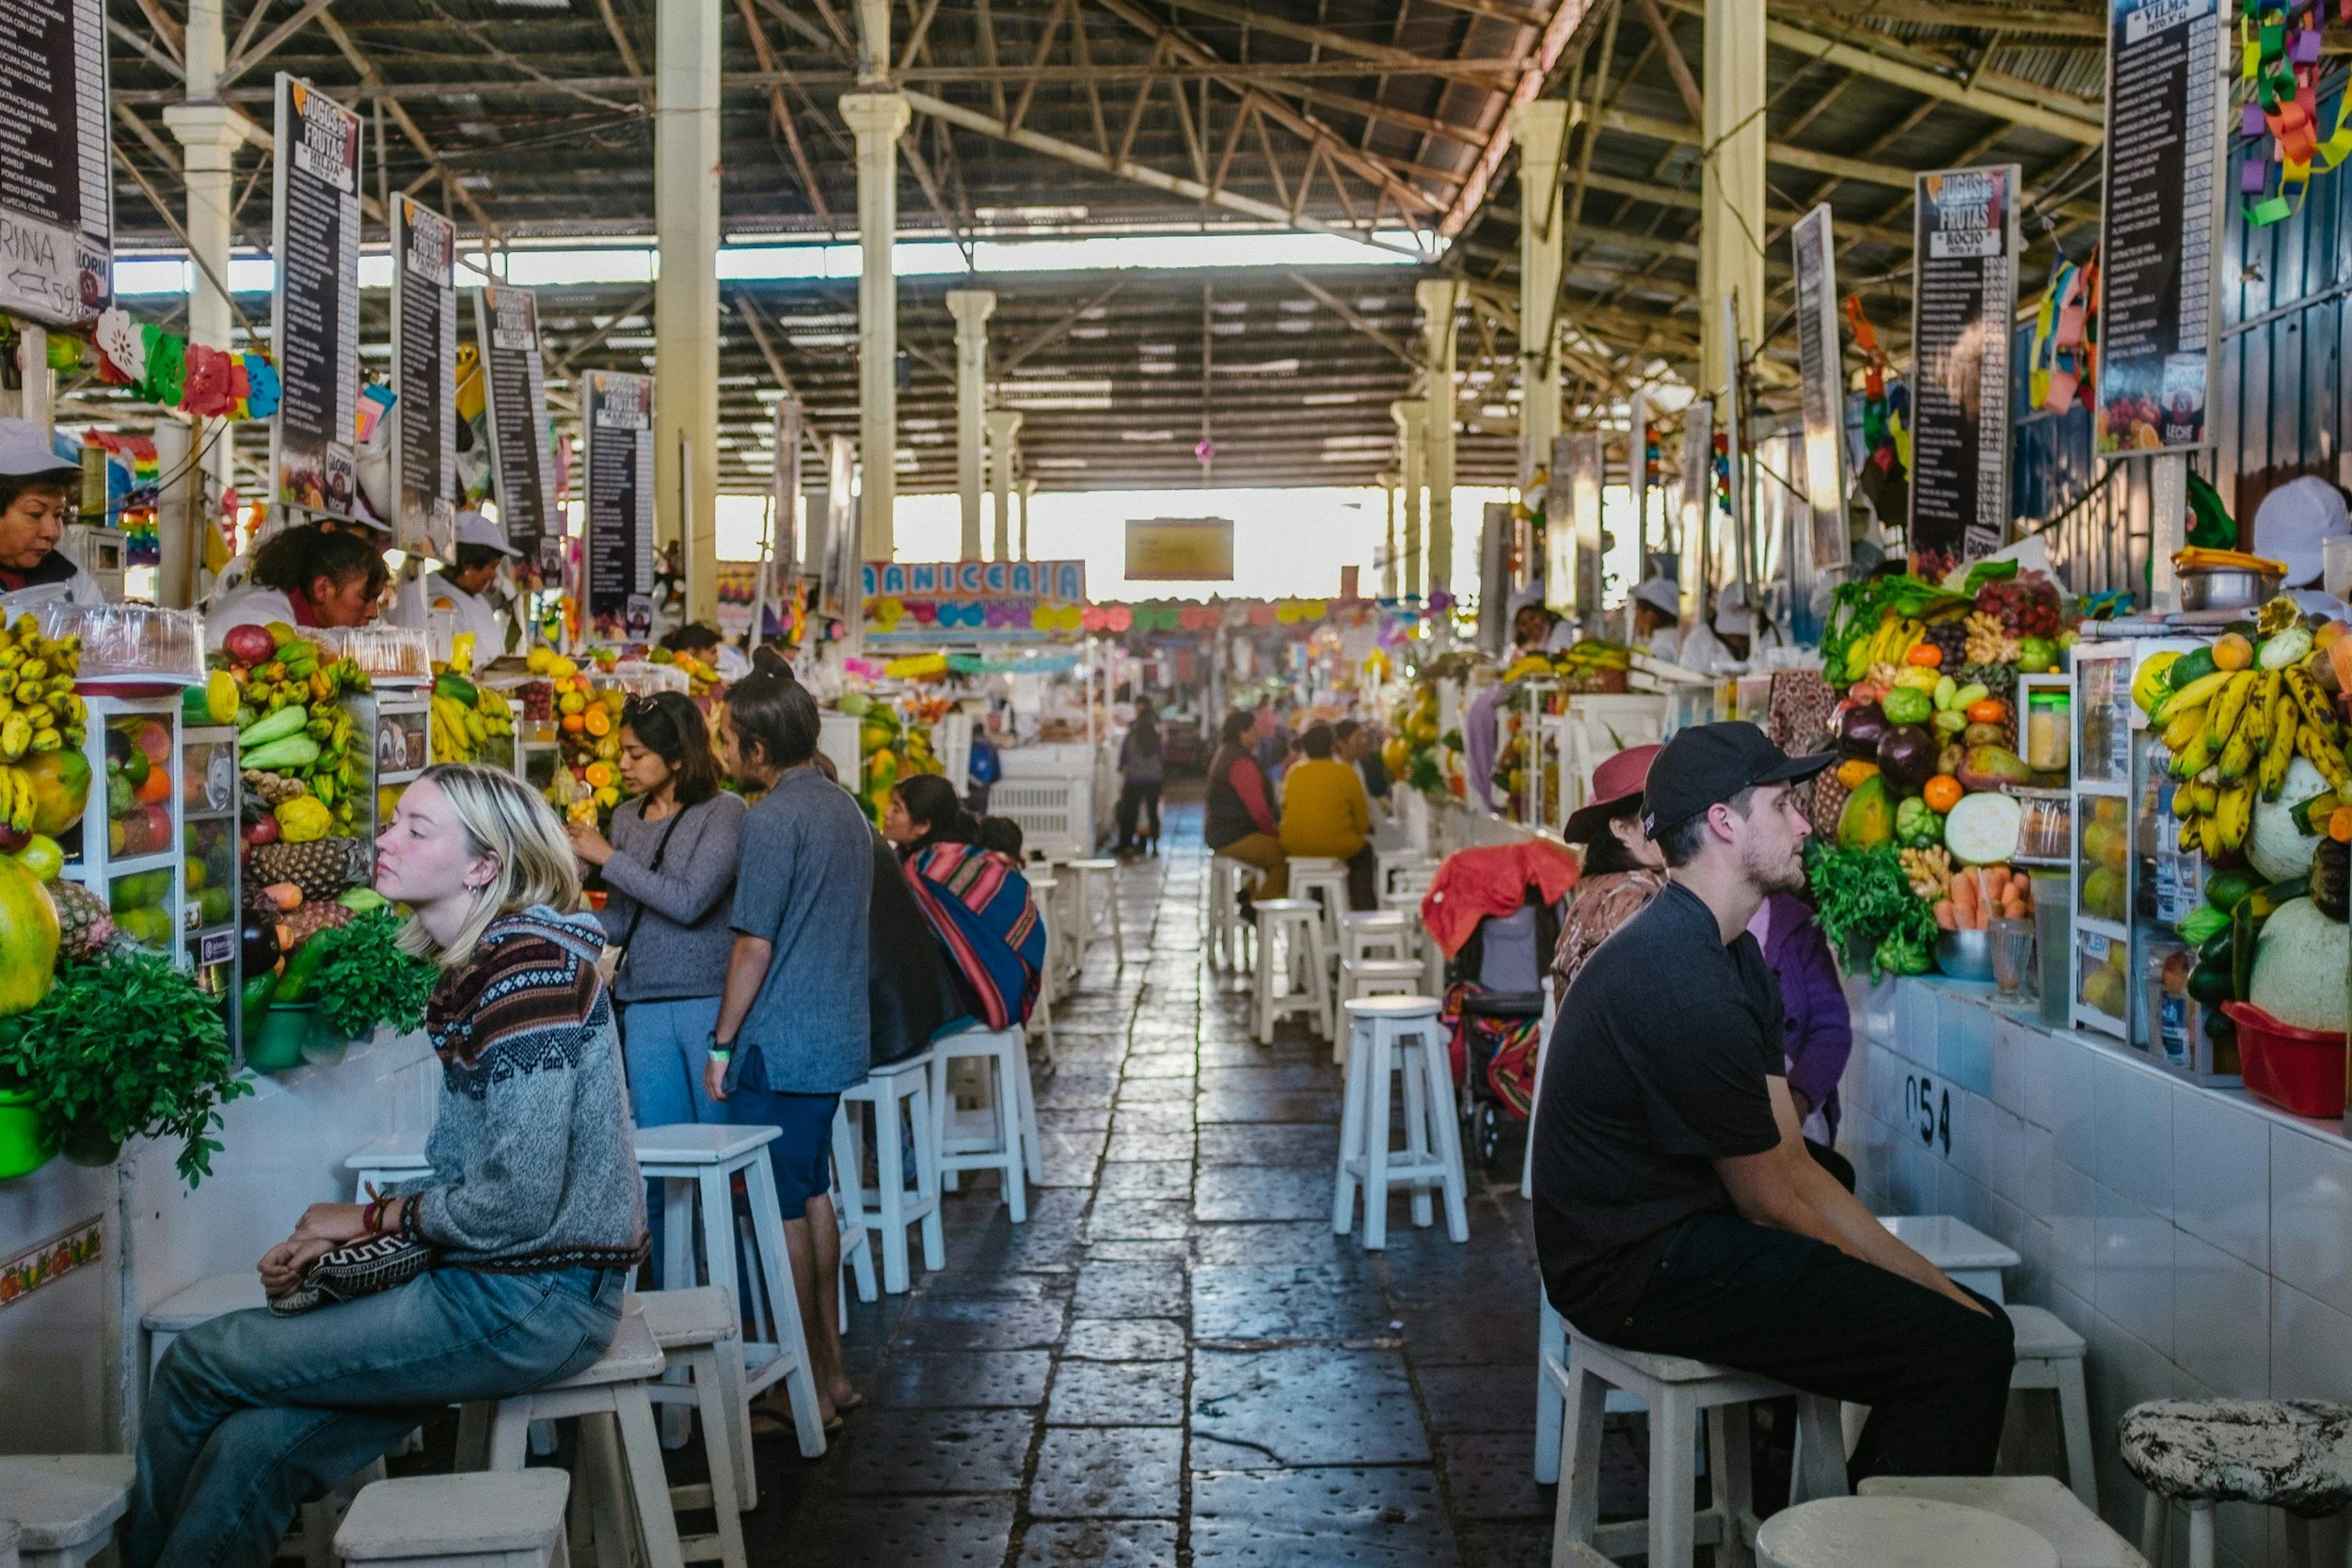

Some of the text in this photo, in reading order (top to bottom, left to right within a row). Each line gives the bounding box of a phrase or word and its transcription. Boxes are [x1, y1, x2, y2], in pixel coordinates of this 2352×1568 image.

[302, 92, 339, 133] JUGOS
[304, 120, 344, 164] FRUTAS
[1938, 172, 1983, 201] JUGOS
[1939, 203, 1990, 231] FRUTAS
[51, 282, 75, 317] 59
